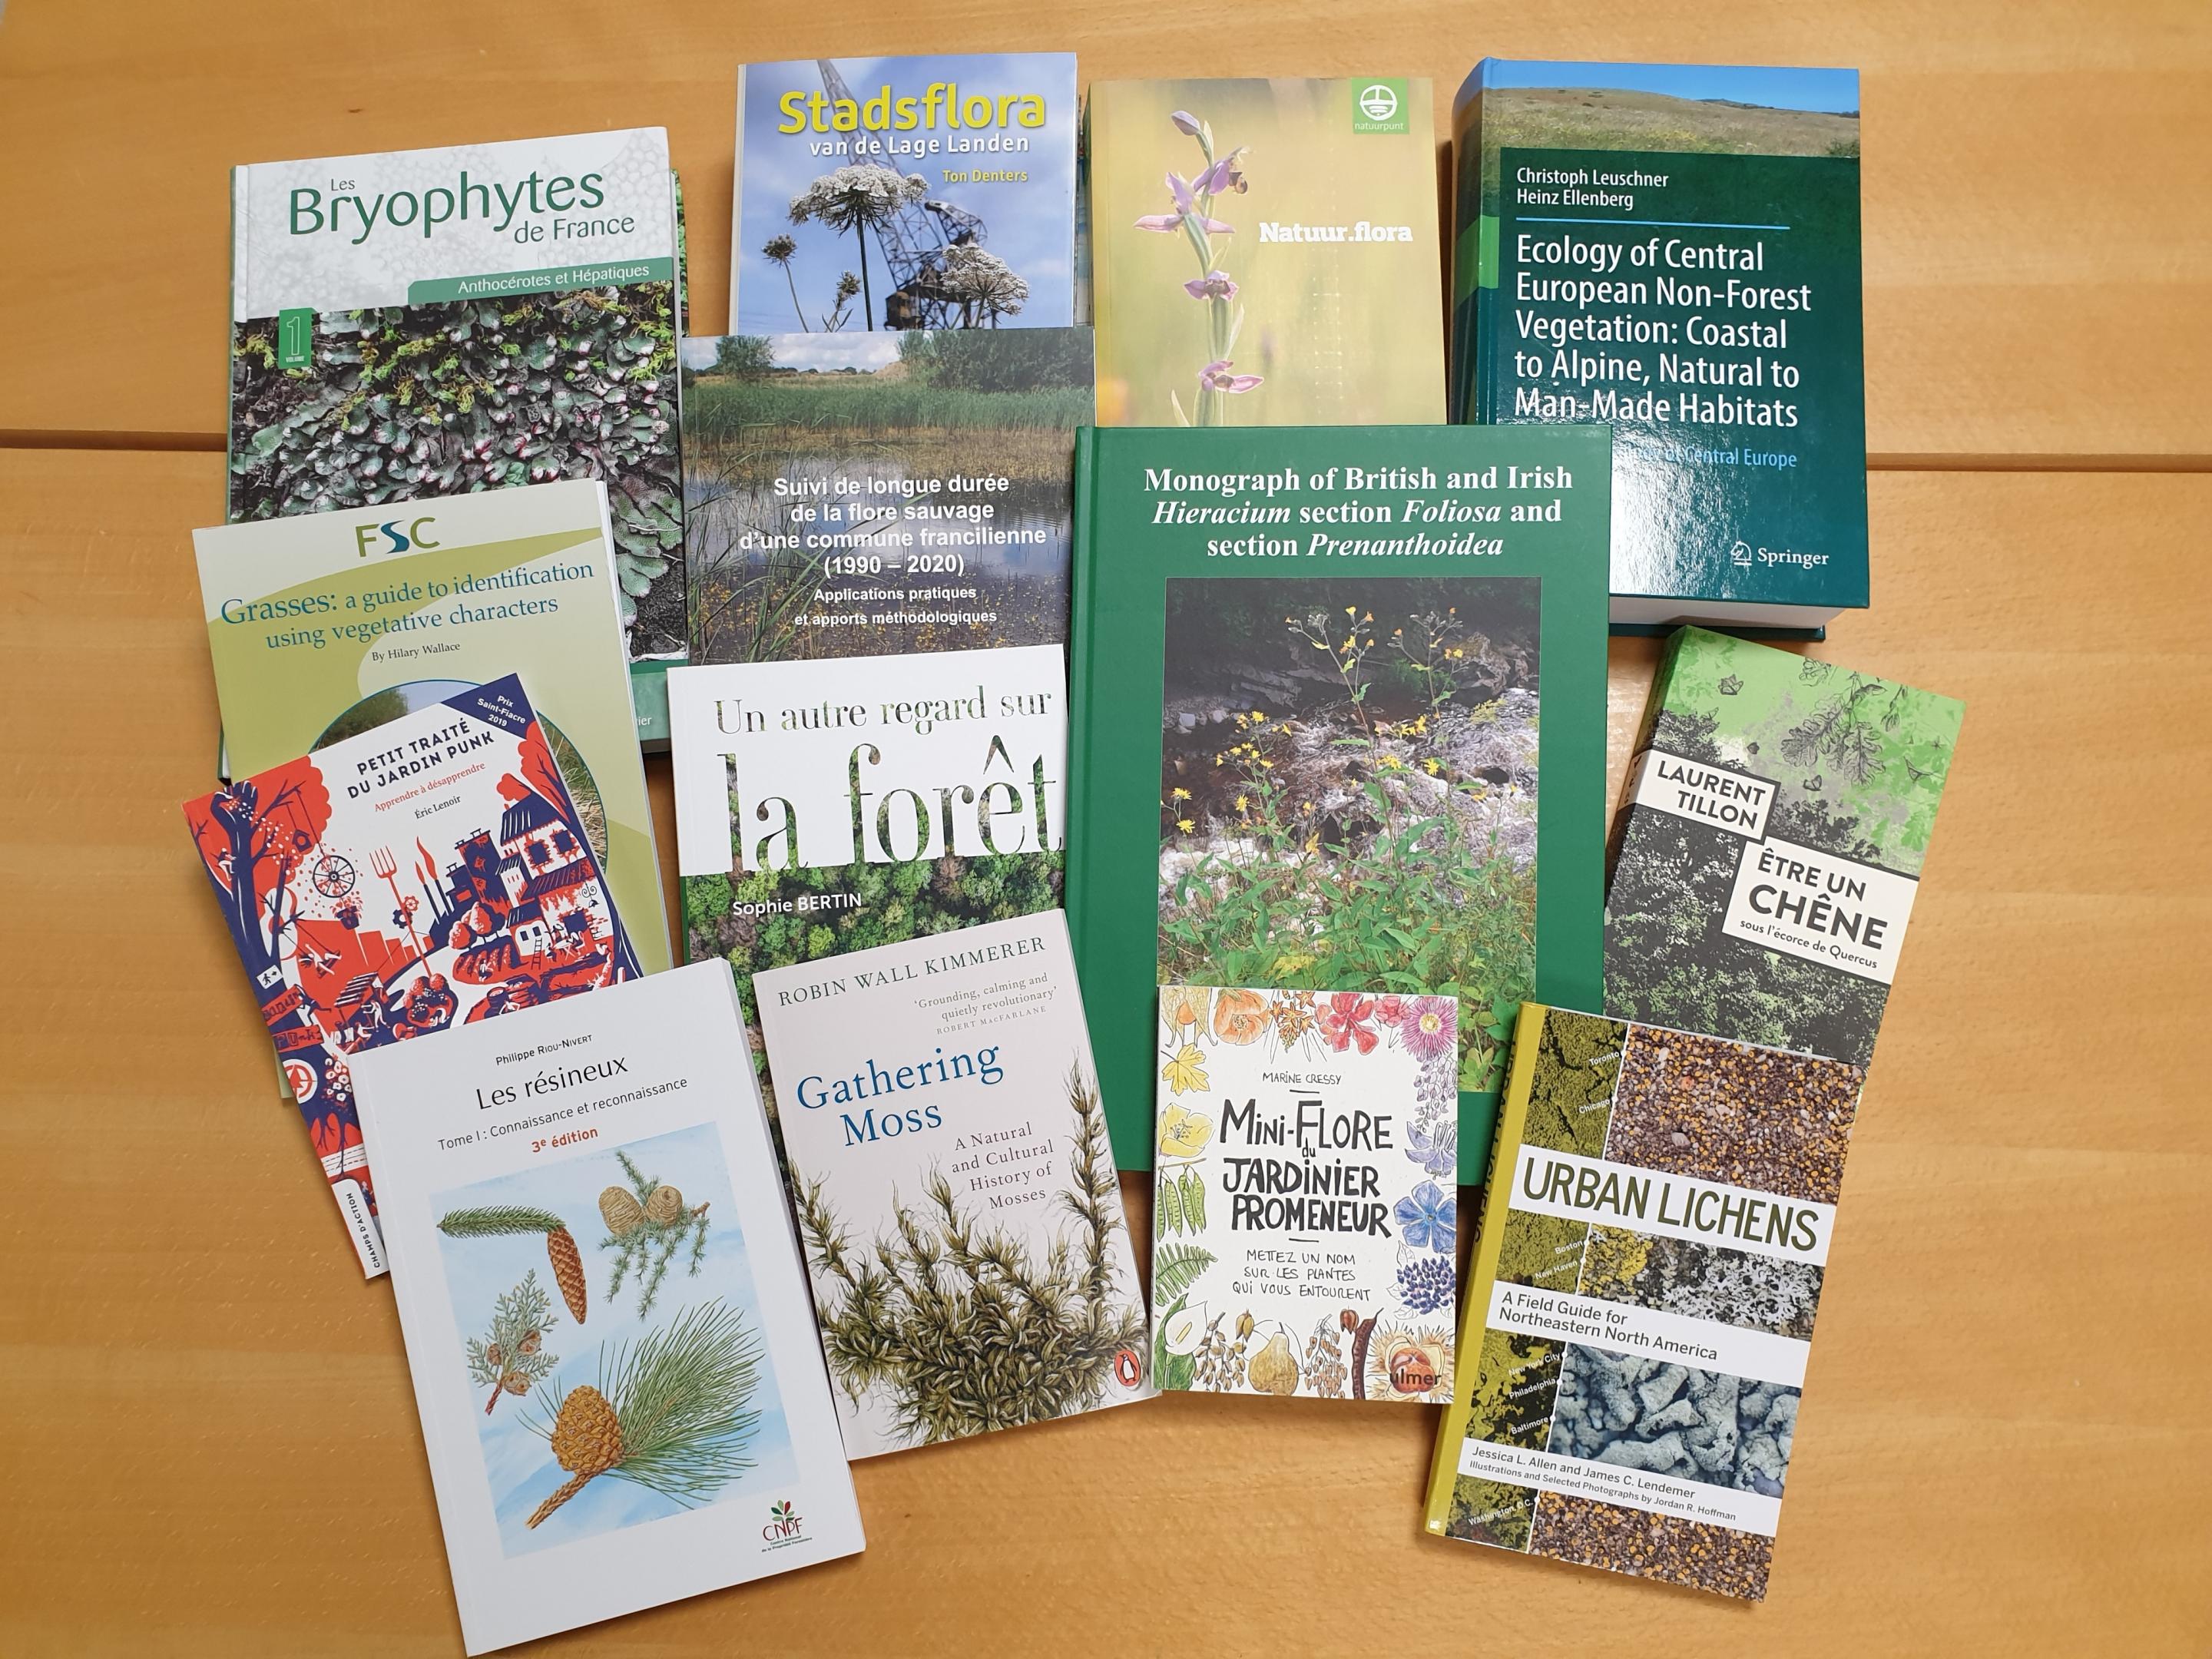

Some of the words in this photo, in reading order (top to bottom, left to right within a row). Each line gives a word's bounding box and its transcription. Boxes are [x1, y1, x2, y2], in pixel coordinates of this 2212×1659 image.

[778, 82, 1045, 134] Stadsflora
[1355, 122, 1403, 131] natuurpunt
[810, 137, 847, 157] van
[889, 137, 939, 158] Lage
[948, 133, 1028, 154] Landen
[330, 178, 356, 192] Les
[943, 170, 967, 184] Ton
[972, 169, 1028, 183] Denters
[1517, 167, 1588, 187] Christoph
[1593, 170, 1669, 188] Leuschner
[290, 171, 604, 244] Bryophytes
[1517, 189, 1558, 206] Heinz
[1564, 190, 1634, 210] Ellenberg
[553, 216, 635, 241] France
[1259, 221, 1413, 243] Natuur.flora
[1518, 234, 1623, 273] Ecology
[1664, 239, 1763, 272] Central
[458, 275, 551, 294] Anthocérotes
[572, 266, 650, 285] Hépatiques
[1518, 273, 1647, 310] European
[1657, 276, 1812, 312] Non-Forest
[1515, 310, 1678, 348] Vegetation:
[1687, 316, 1786, 349] Coastal
[1551, 350, 1650, 386] Alpine,
[1660, 353, 1762, 385] Natural
[1515, 388, 1671, 422] Man-Made
[1680, 392, 1798, 428] Habitats
[1685, 446, 1739, 465] Central
[1744, 449, 1797, 470] Europe
[774, 477, 827, 496] Suivi
[868, 475, 941, 498] longue
[948, 473, 1009, 493] durée
[1144, 468, 1300, 498] Monograph
[1343, 466, 1437, 490] British
[1446, 466, 1498, 489] and
[1507, 465, 1573, 489] Irish
[849, 502, 898, 521] flore
[904, 505, 995, 524] sauvage
[1151, 501, 1291, 524] Hieracium
[1300, 500, 1392, 524] section
[1400, 499, 1502, 523] Foliosa
[1510, 499, 1561, 522] and
[355, 517, 440, 558] FSC
[806, 528, 915, 548] commune
[918, 526, 1047, 548] francilienne
[1207, 533, 1298, 557] section
[1306, 532, 1504, 556] Prenanthoidea
[824, 555, 882, 578] (1990
[907, 553, 965, 577] 2020)
[1757, 547, 1829, 569] Springer
[220, 594, 337, 624] Grasses:
[363, 582, 423, 614] guide
[453, 561, 594, 596] identification
[813, 587, 905, 604] Applications
[909, 586, 979, 602] pratiques
[267, 628, 326, 649] using
[332, 611, 442, 644] vegetative
[449, 598, 558, 624] characters
[812, 612, 868, 628] apports
[872, 610, 998, 627] méthodologiques
[387, 648, 419, 659] Hilary
[422, 643, 461, 654] Wallace
[477, 698, 526, 724] Saint-Fiacre
[497, 695, 514, 707] Prix
[781, 700, 867, 730] autre
[881, 686, 987, 735] regard
[1001, 694, 1051, 717] sur
[488, 714, 508, 727] 2019
[356, 747, 404, 776] PETIT
[408, 717, 470, 753] TRAITÉ
[377, 751, 442, 787] JARDIN
[446, 730, 495, 759] PUNK
[375, 790, 419, 812] Apprendre
[427, 763, 486, 790] désapprendre
[1657, 760, 1767, 806] LAURENT
[414, 807, 433, 820] Éric
[432, 796, 461, 812] Lenoir
[843, 735, 1061, 864] forêt
[1678, 790, 1758, 830] TILLON
[1757, 848, 1822, 888] ÊTRE
[733, 898, 793, 919] Sophie
[797, 892, 862, 914] BERTIN
[1749, 884, 1888, 950] CHÊNE
[1740, 920, 1764, 934] sous
[1830, 945, 1877, 969] Quercus
[778, 979, 846, 1006] ROBIN
[853, 965, 918, 989] WALL
[924, 937, 1045, 975] KIMMERER
[983, 979, 1027, 995] calming
[1028, 972, 1048, 985] and
[942, 1004, 979, 1022] quietly
[936, 1020, 976, 1035] ROBERT
[495, 1050, 535, 1066] Philippe
[1589, 1051, 1619, 1066] Toronto
[476, 1086, 517, 1110] Les
[525, 1057, 628, 1098] résineux
[797, 1046, 1004, 1109] Gathering
[1305, 1073, 1342, 1085] CRESSY
[438, 1134, 473, 1151] Tome
[490, 1108, 574, 1137] Connaissance
[592, 1078, 687, 1111] reconnaissance
[1578, 1099, 1611, 1114] Chicago
[551, 1128, 598, 1148] édition
[839, 1105, 942, 1147] Moss
[970, 1121, 1032, 1147] Natural
[952, 1154, 980, 1174] and
[985, 1138, 1054, 1165] Cultural
[969, 1171, 1031, 1191] History
[988, 1190, 1046, 1210] Mosses
[1523, 1157, 1651, 1220] URBAN
[1657, 1183, 1819, 1251] LICHENS
[1231, 1194, 1392, 1239] PROMENEUR
[363, 1234, 380, 1268] CHAMPS
[1247, 1249, 1297, 1263] METTEZ
[1326, 1253, 1356, 1265] NOM
[1555, 1240, 1583, 1254] Boston
[1243, 1266, 1270, 1279] SUR
[1277, 1267, 1299, 1280] LES
[1307, 1267, 1356, 1281] PLANTES
[1553, 1260, 1578, 1273] Haven
[1260, 1283, 1291, 1296] VOUS
[1299, 1284, 1371, 1302] ENTOURENT
[1517, 1293, 1554, 1312] Field
[1558, 1300, 1601, 1320] Guide
[1606, 1310, 1628, 1326] for
[1499, 1306, 1601, 1337] Northeastern
[1604, 1326, 1649, 1347] North
[1652, 1336, 1717, 1360] America
[1527, 1357, 1544, 1369] York
[1545, 1353, 1560, 1363] City
[1390, 1368, 1442, 1385] ulmer
[1509, 1378, 1556, 1399] Philadelphia
[1511, 1416, 1548, 1435] Baltimore
[1472, 1446, 1514, 1463] Jessica
[1528, 1456, 1557, 1471] Allen
[1559, 1465, 1581, 1475] and
[1583, 1467, 1621, 1483] James
[1637, 1477, 1696, 1498] Lendemer
[1469, 1460, 1522, 1478] Illustrations
[1524, 1472, 1541, 1481] and
[1542, 1474, 1581, 1488] Selected
[1582, 1482, 1639, 1501] Photographs
[1654, 1497, 1684, 1510] Jordan
[1697, 1505, 1736, 1522] Hoffman
[763, 1517, 803, 1541] CNPF
